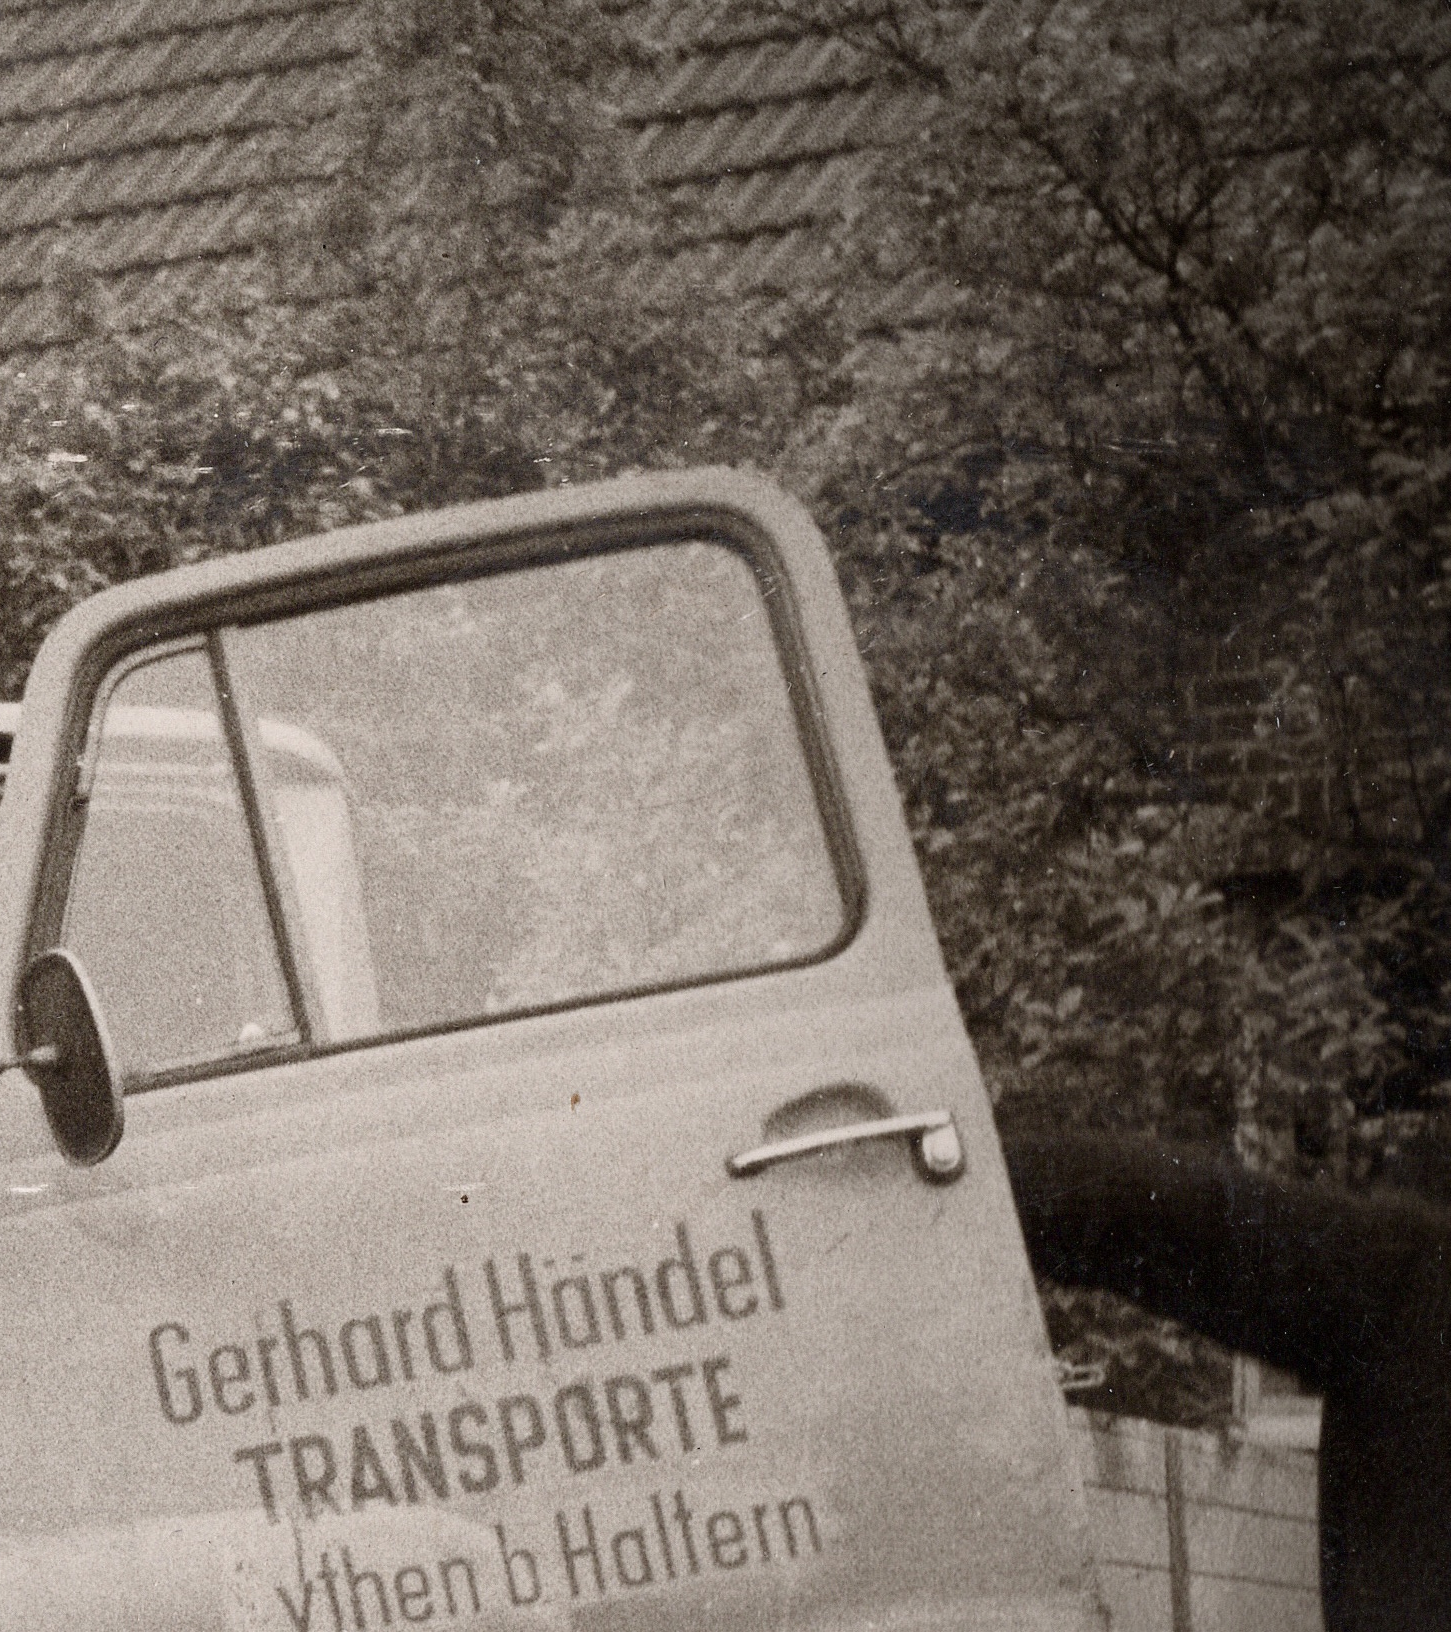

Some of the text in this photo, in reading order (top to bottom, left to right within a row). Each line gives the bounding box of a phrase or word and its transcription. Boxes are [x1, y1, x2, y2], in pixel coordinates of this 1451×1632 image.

[148, 1209, 787, 1425] Gerhard Händel
[234, 1358, 749, 1526] TRANSPORTE
[495, 1522, 542, 1608] b
[556, 1490, 823, 1600] Haltern
